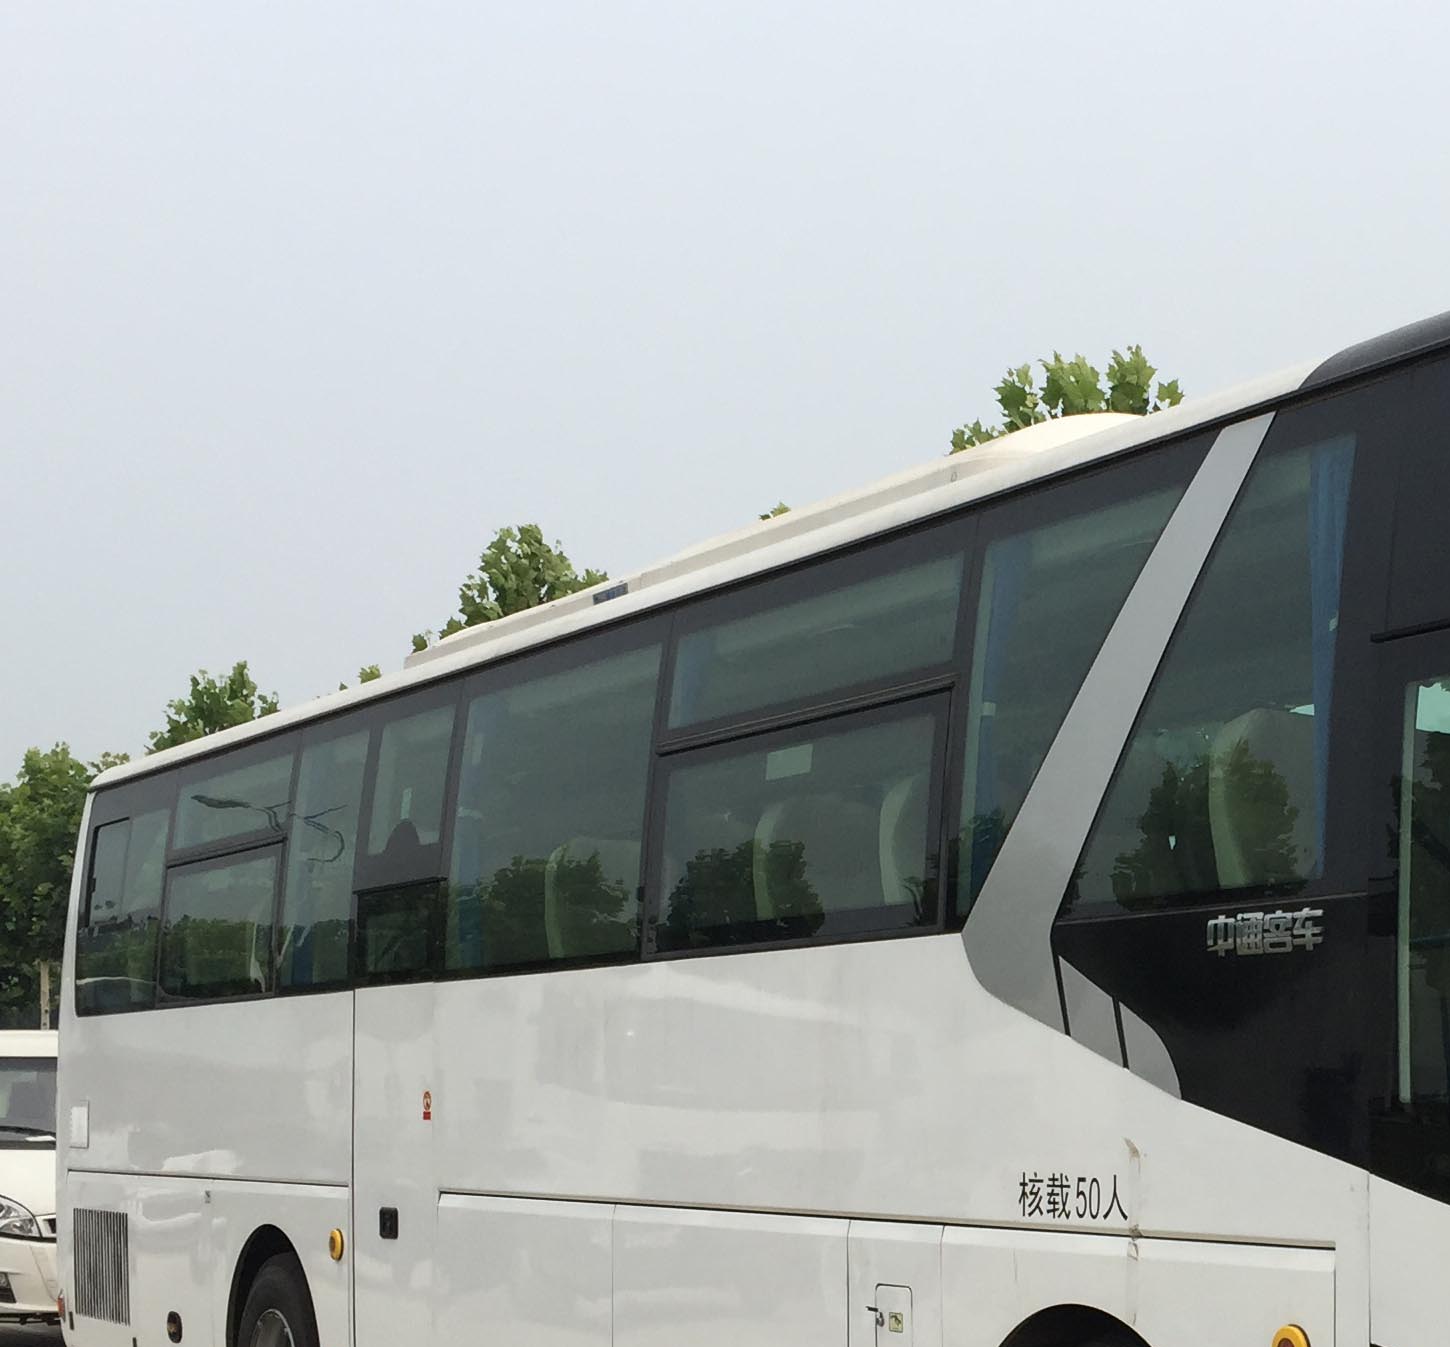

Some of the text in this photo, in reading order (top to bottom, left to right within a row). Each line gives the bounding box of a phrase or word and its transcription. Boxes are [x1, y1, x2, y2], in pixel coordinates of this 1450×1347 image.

[1207, 907, 1323, 957] 中通客车
[1019, 1171, 1128, 1221] 核载50人
